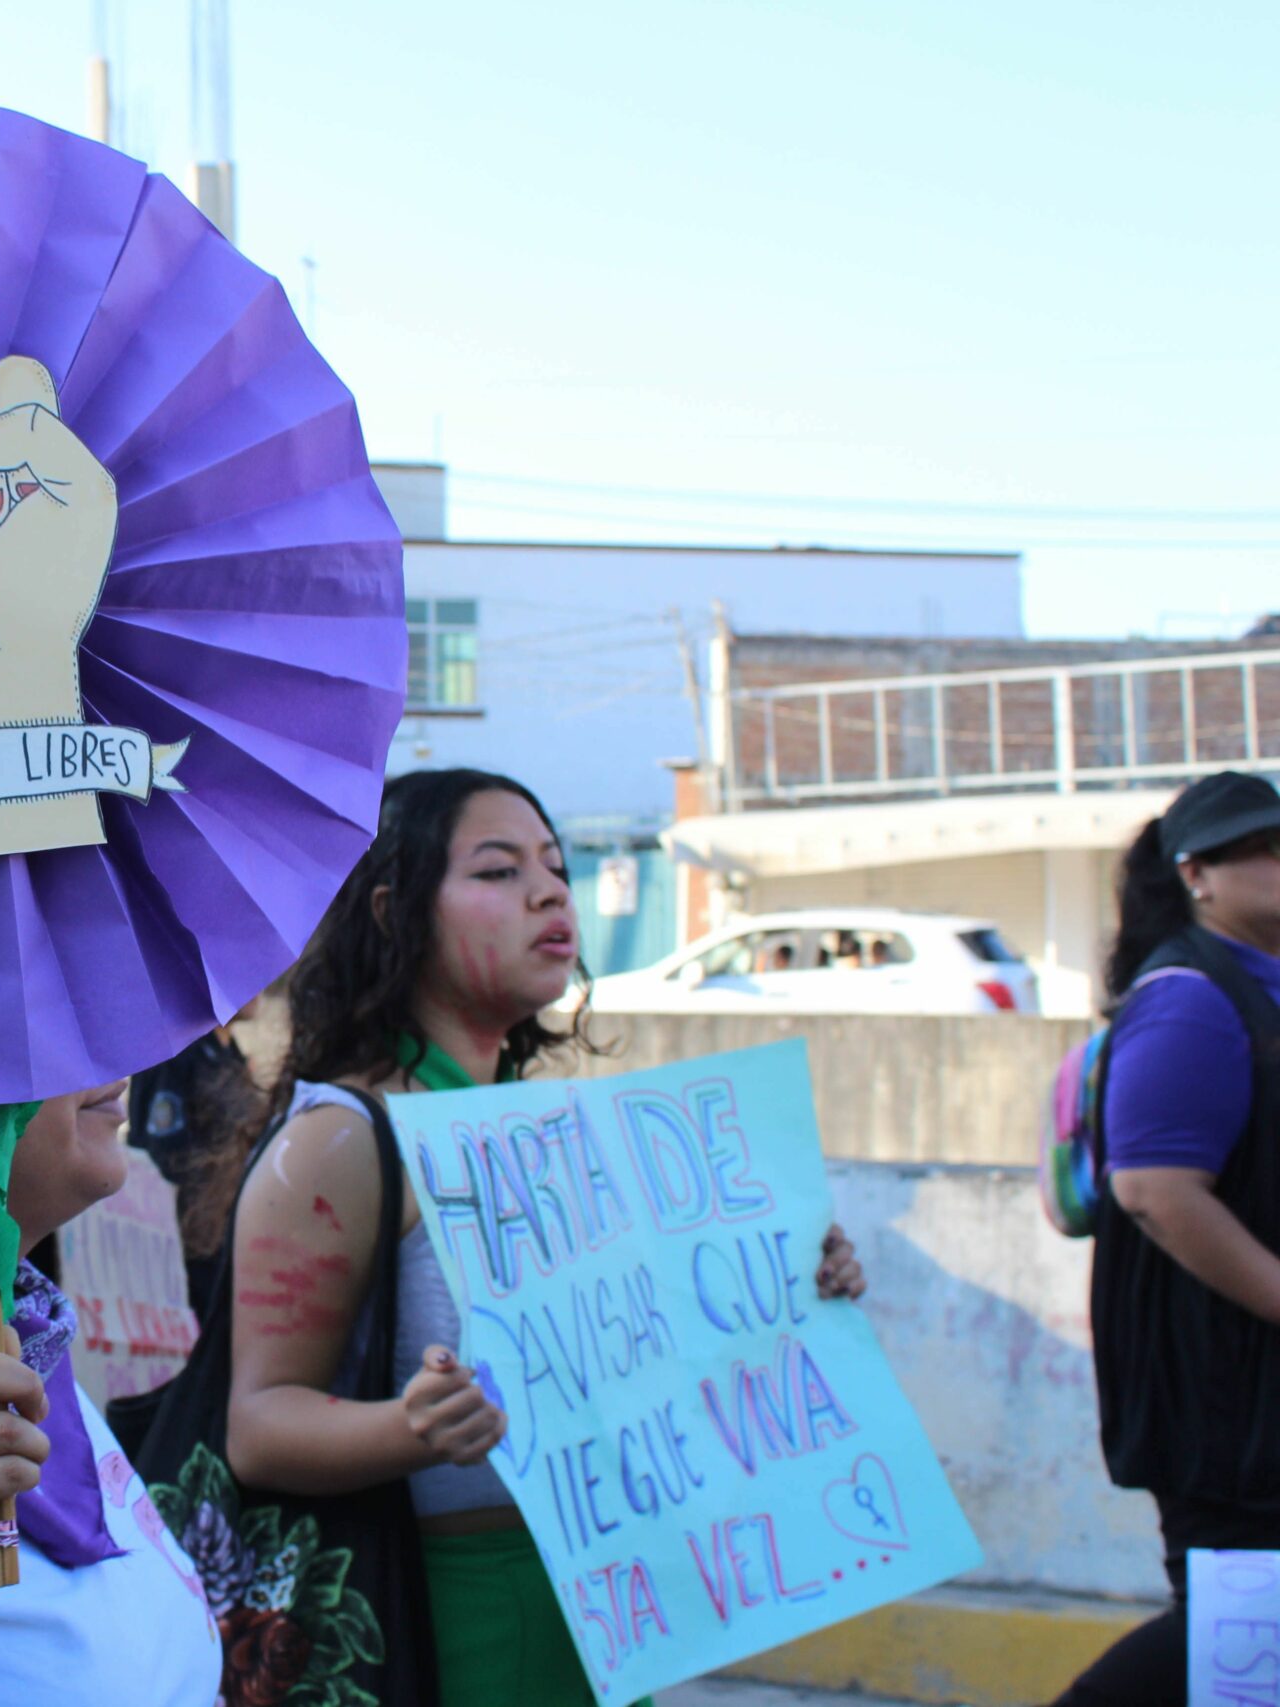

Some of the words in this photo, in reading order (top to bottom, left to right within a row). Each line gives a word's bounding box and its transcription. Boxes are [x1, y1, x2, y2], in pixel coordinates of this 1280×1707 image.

[22, 731, 138, 788] LIBRES
[404, 1086, 634, 1299] HARTA
[611, 1077, 777, 1235] DE
[692, 1230, 808, 1337] QUE
[698, 1332, 860, 1479] VIVA
